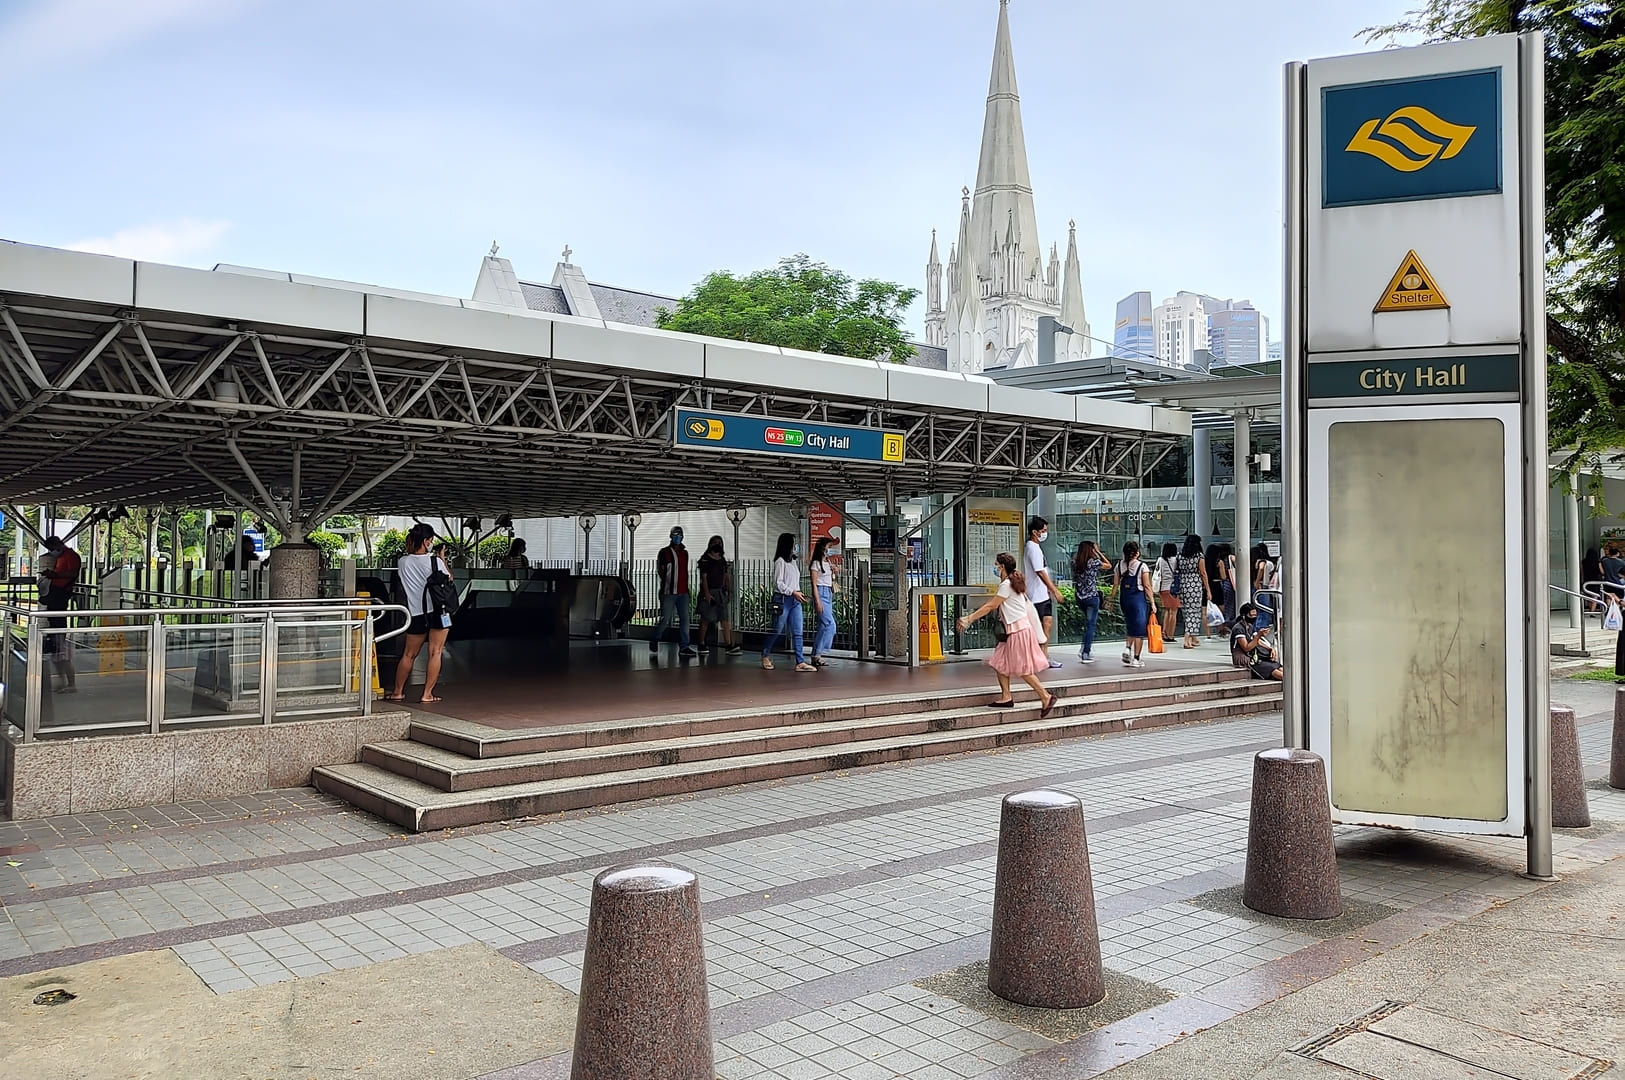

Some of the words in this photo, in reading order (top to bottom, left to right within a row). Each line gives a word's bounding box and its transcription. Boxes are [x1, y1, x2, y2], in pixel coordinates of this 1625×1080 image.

[1391, 293, 1434, 304] Shelter
[1359, 368, 1407, 393] City
[1416, 364, 1466, 387] Hall
[767, 432, 776, 440] NS
[776, 433, 785, 441] 25
[807, 433, 827, 450] City
[829, 436, 850, 449] Hall
[890, 442, 897, 453] B
